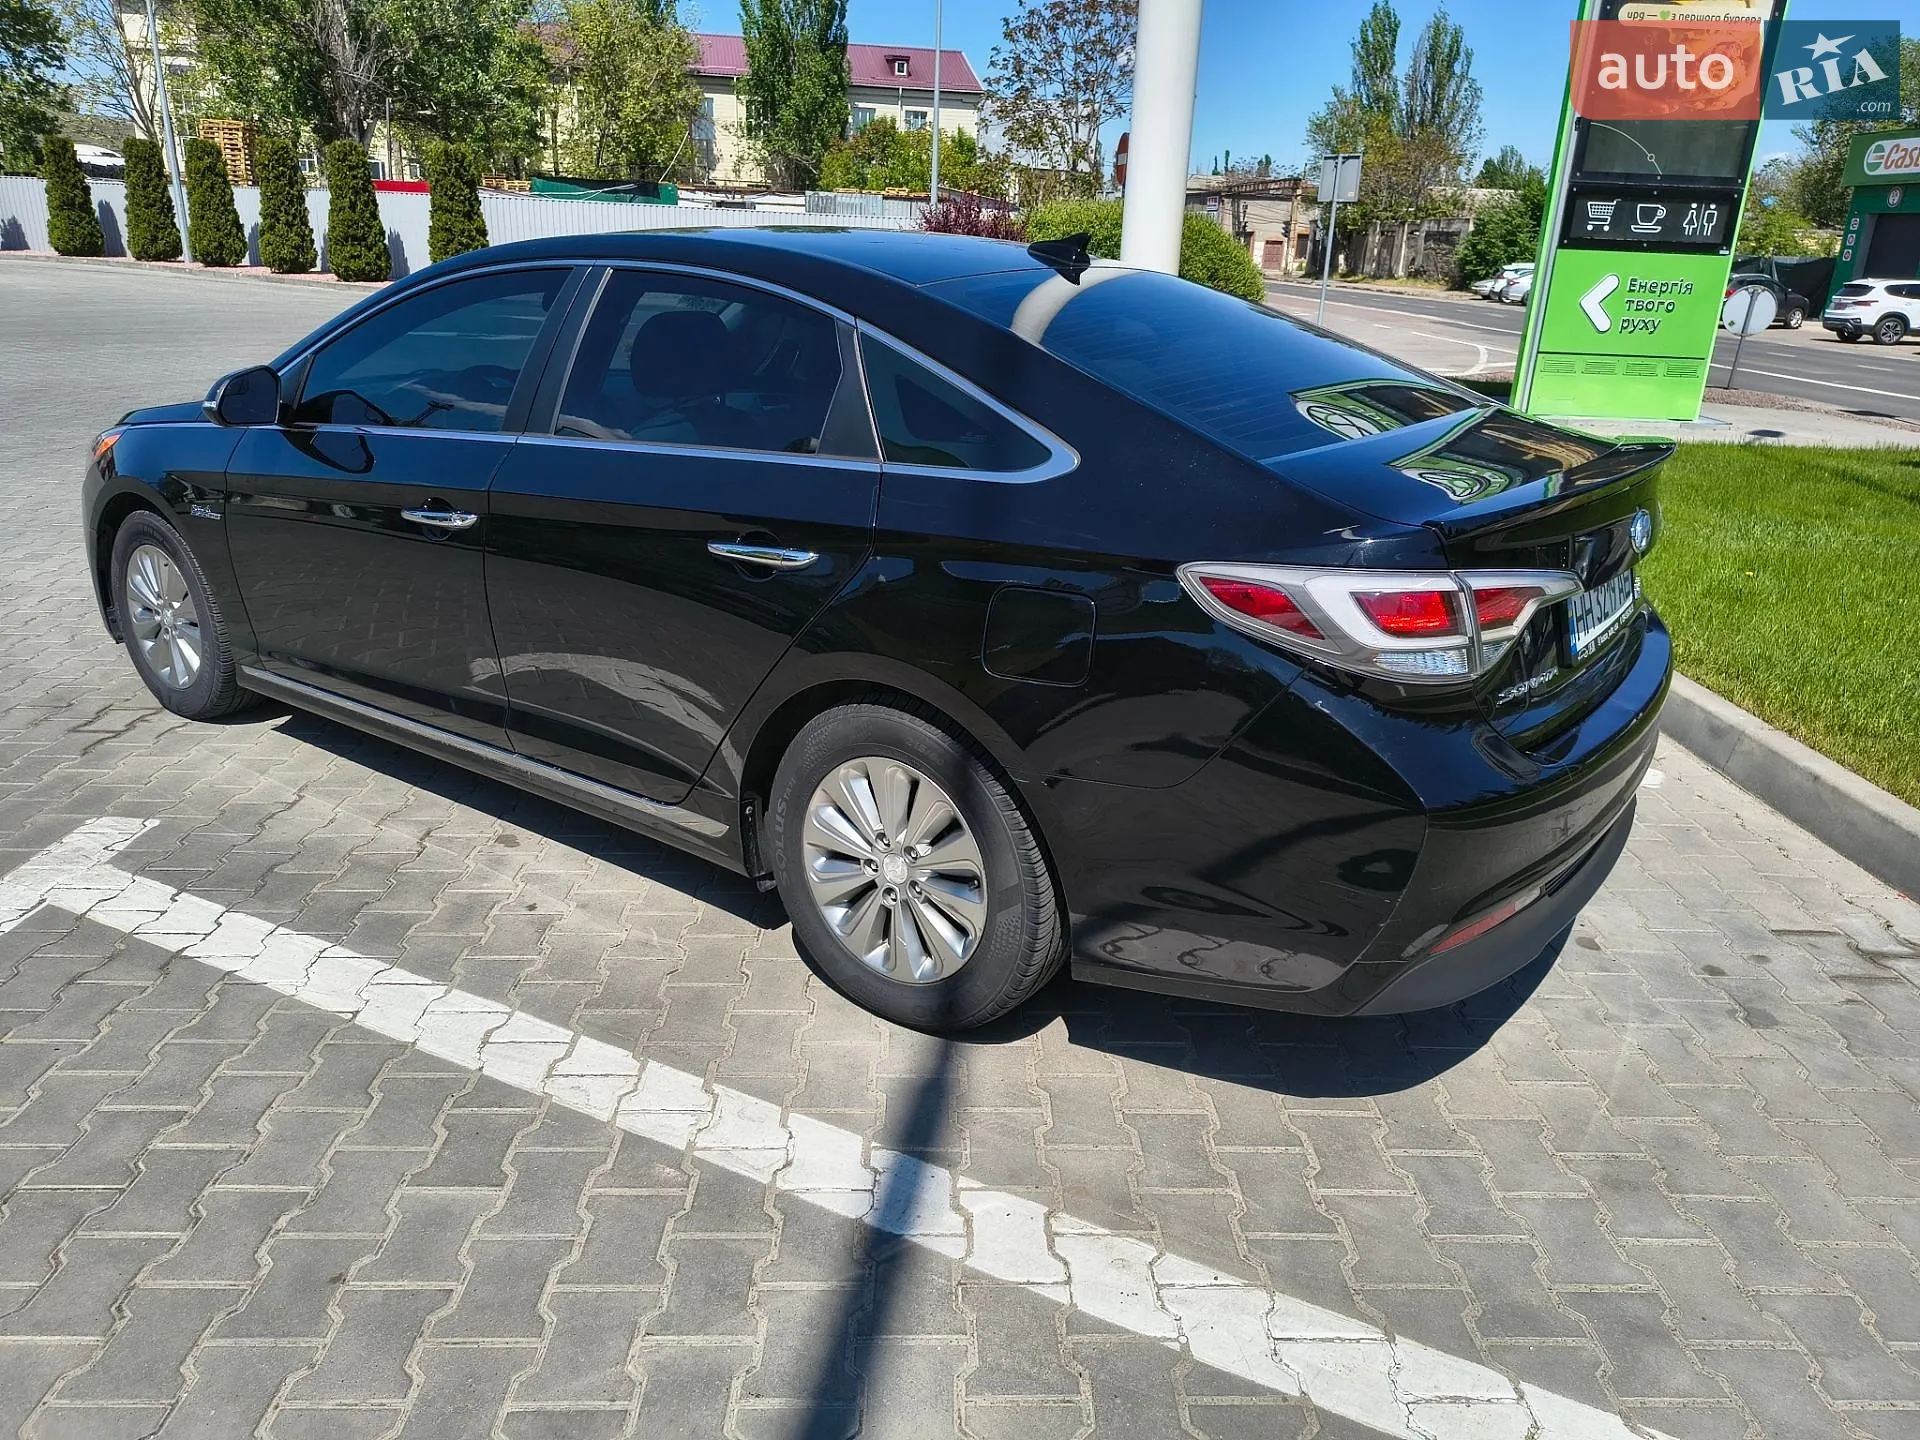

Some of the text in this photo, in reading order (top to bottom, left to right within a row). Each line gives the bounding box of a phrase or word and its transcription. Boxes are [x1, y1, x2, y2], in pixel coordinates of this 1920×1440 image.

[1626, 11, 1645, 21] upg
[1678, 13, 1721, 22] першого
[1723, 13, 1762, 26] бургера
[1627, 277, 1694, 297] Енергія
[1625, 299, 1676, 313] твого
[1619, 318, 1661, 335] руху
[775, 799, 790, 884] SOLUS
